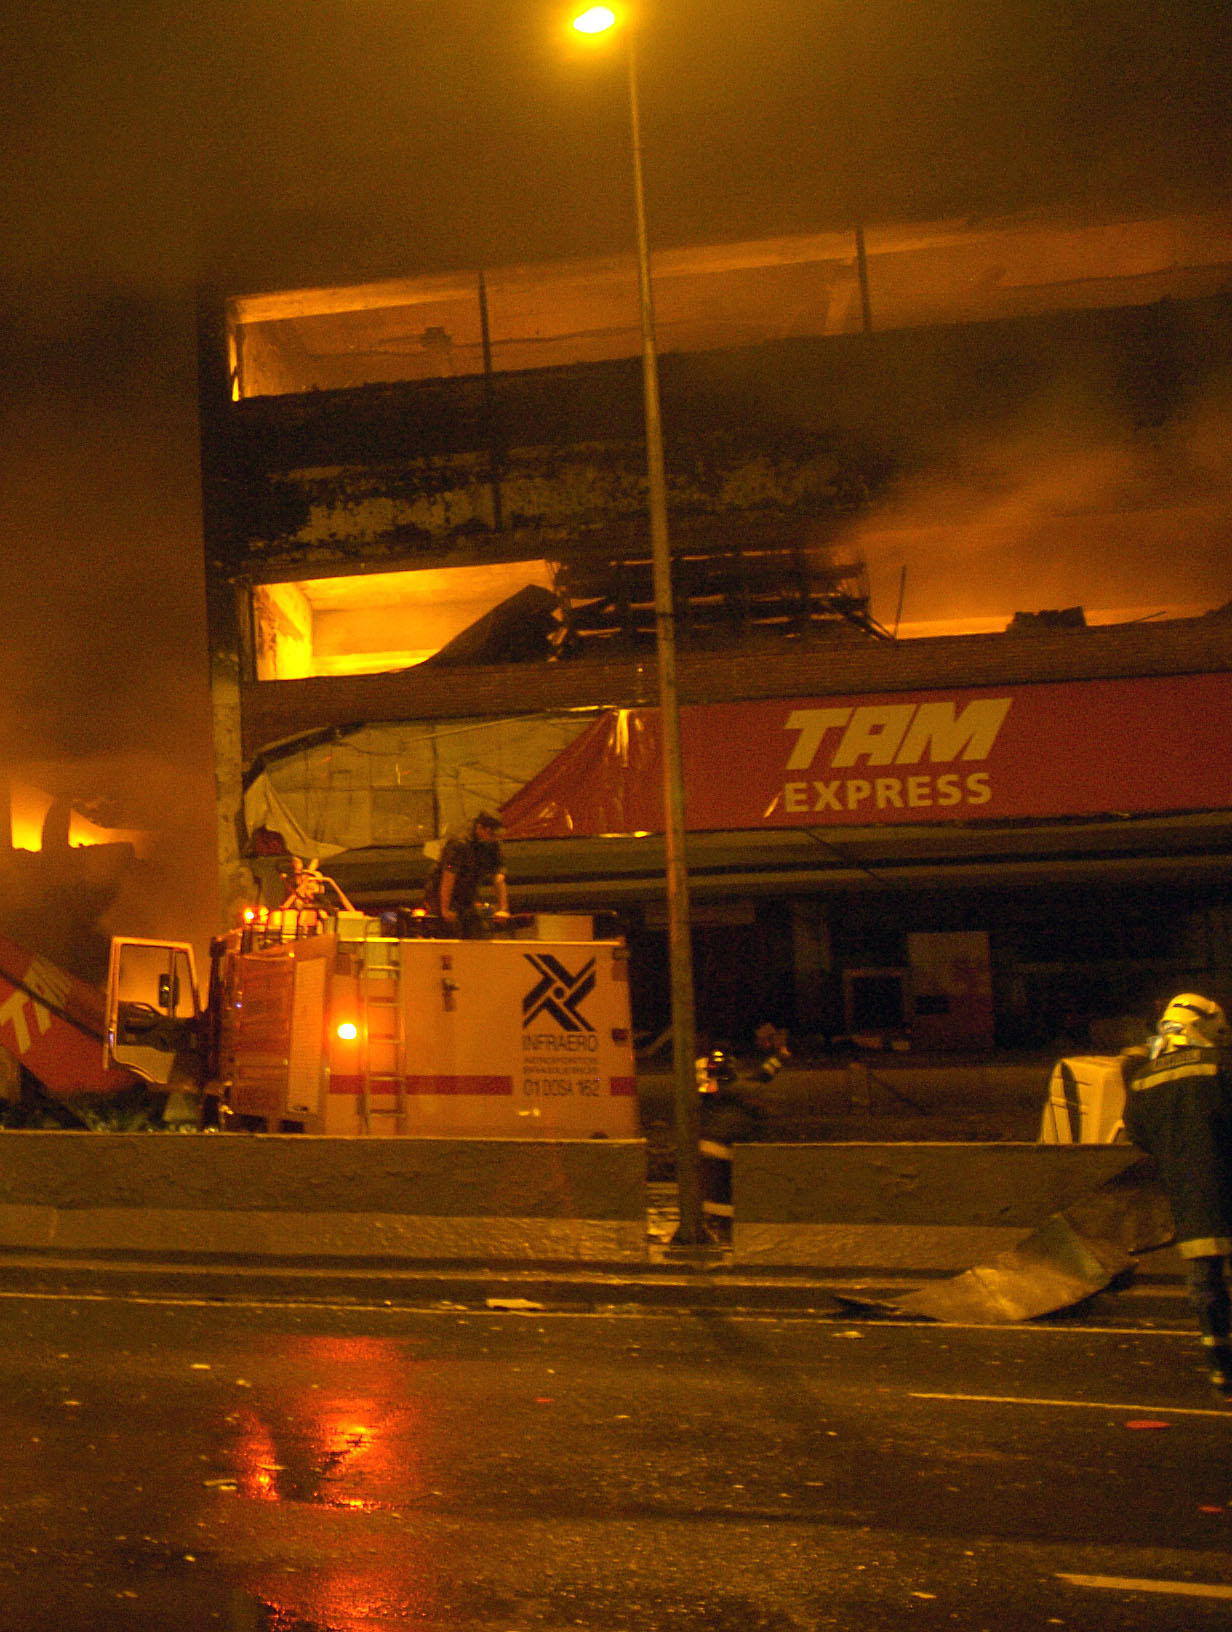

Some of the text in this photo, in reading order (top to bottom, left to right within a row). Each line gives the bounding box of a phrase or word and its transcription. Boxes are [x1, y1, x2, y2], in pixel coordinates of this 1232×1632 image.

[784, 697, 1013, 770] TAM
[785, 772, 993, 813] EXPRESS
[522, 1034, 599, 1052] INFRAERO
